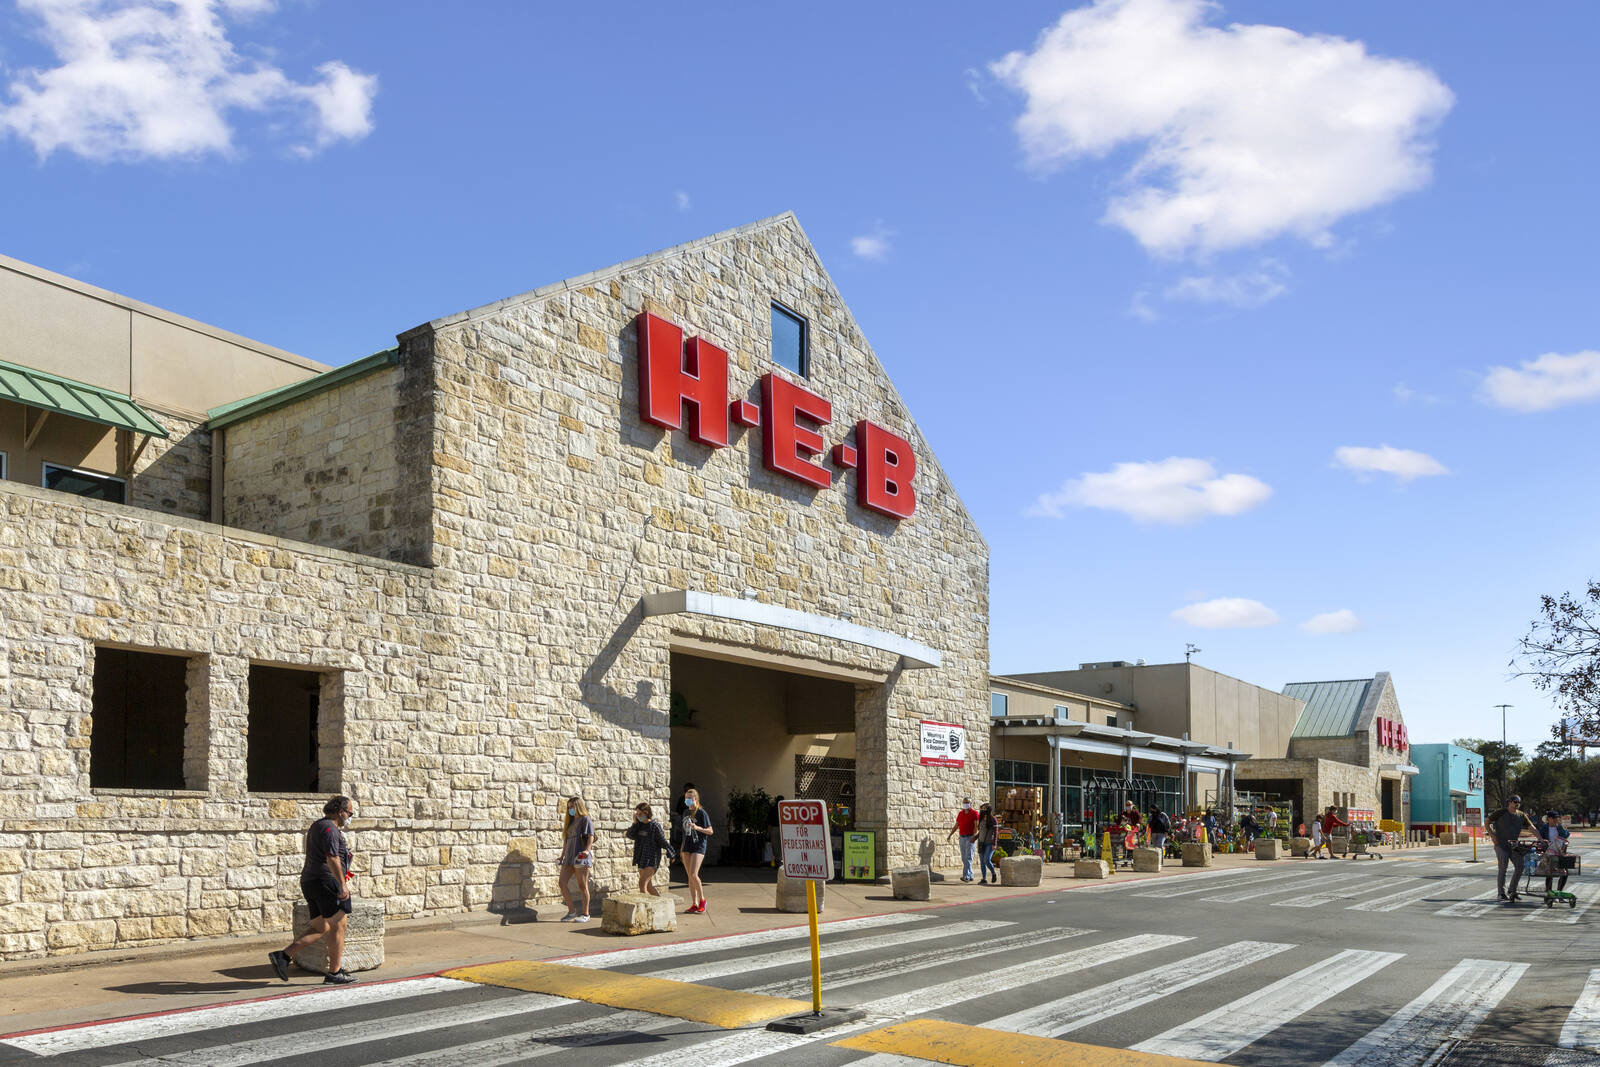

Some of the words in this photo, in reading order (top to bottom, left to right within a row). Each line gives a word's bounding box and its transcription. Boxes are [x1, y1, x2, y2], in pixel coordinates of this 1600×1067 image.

[637, 311, 916, 520] H-E-B
[783, 806, 819, 821] STOP
[796, 827, 808, 837] FOR
[784, 839, 824, 849] PEDESTRIANS
[801, 852, 808, 862] IN
[788, 864, 824, 875] CROSSWALK
